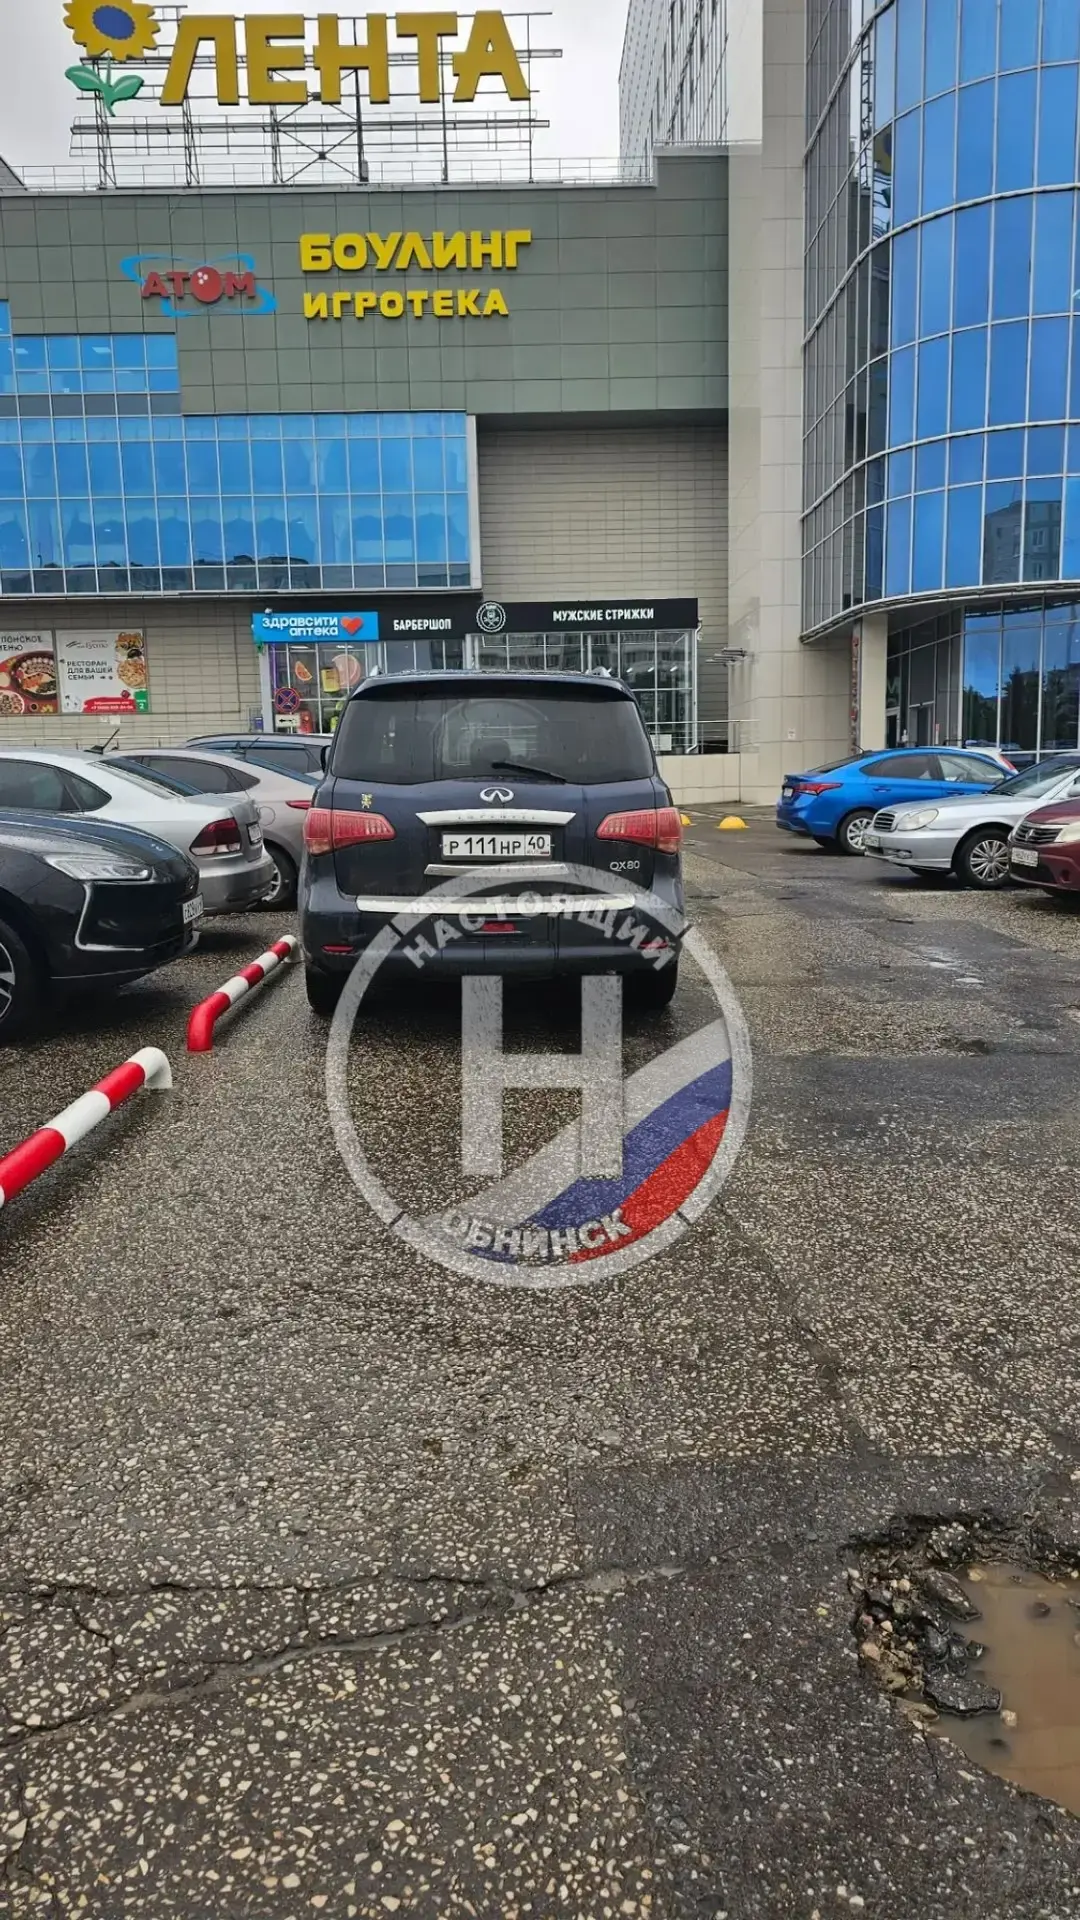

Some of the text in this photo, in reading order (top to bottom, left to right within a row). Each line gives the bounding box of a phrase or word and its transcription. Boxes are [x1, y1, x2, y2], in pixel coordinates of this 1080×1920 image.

[159, 10, 531, 106] ЛЕНТА
[300, 229, 532, 271] БОУЛИНГ
[141, 266, 257, 303] АТОМ
[303, 288, 509, 319] ИГРОТЕКА
[552, 607, 654, 623] МУЖСКИЕ СТРИЖКИ
[262, 616, 339, 630] здравсити
[393, 618, 452, 631] БАРБЕРШОП
[289, 627, 339, 636] аптека
[0, 635, 43, 643] ПОНСКОЕ
[528, 836, 545, 850] 40
[609, 860, 640, 872] QX80
